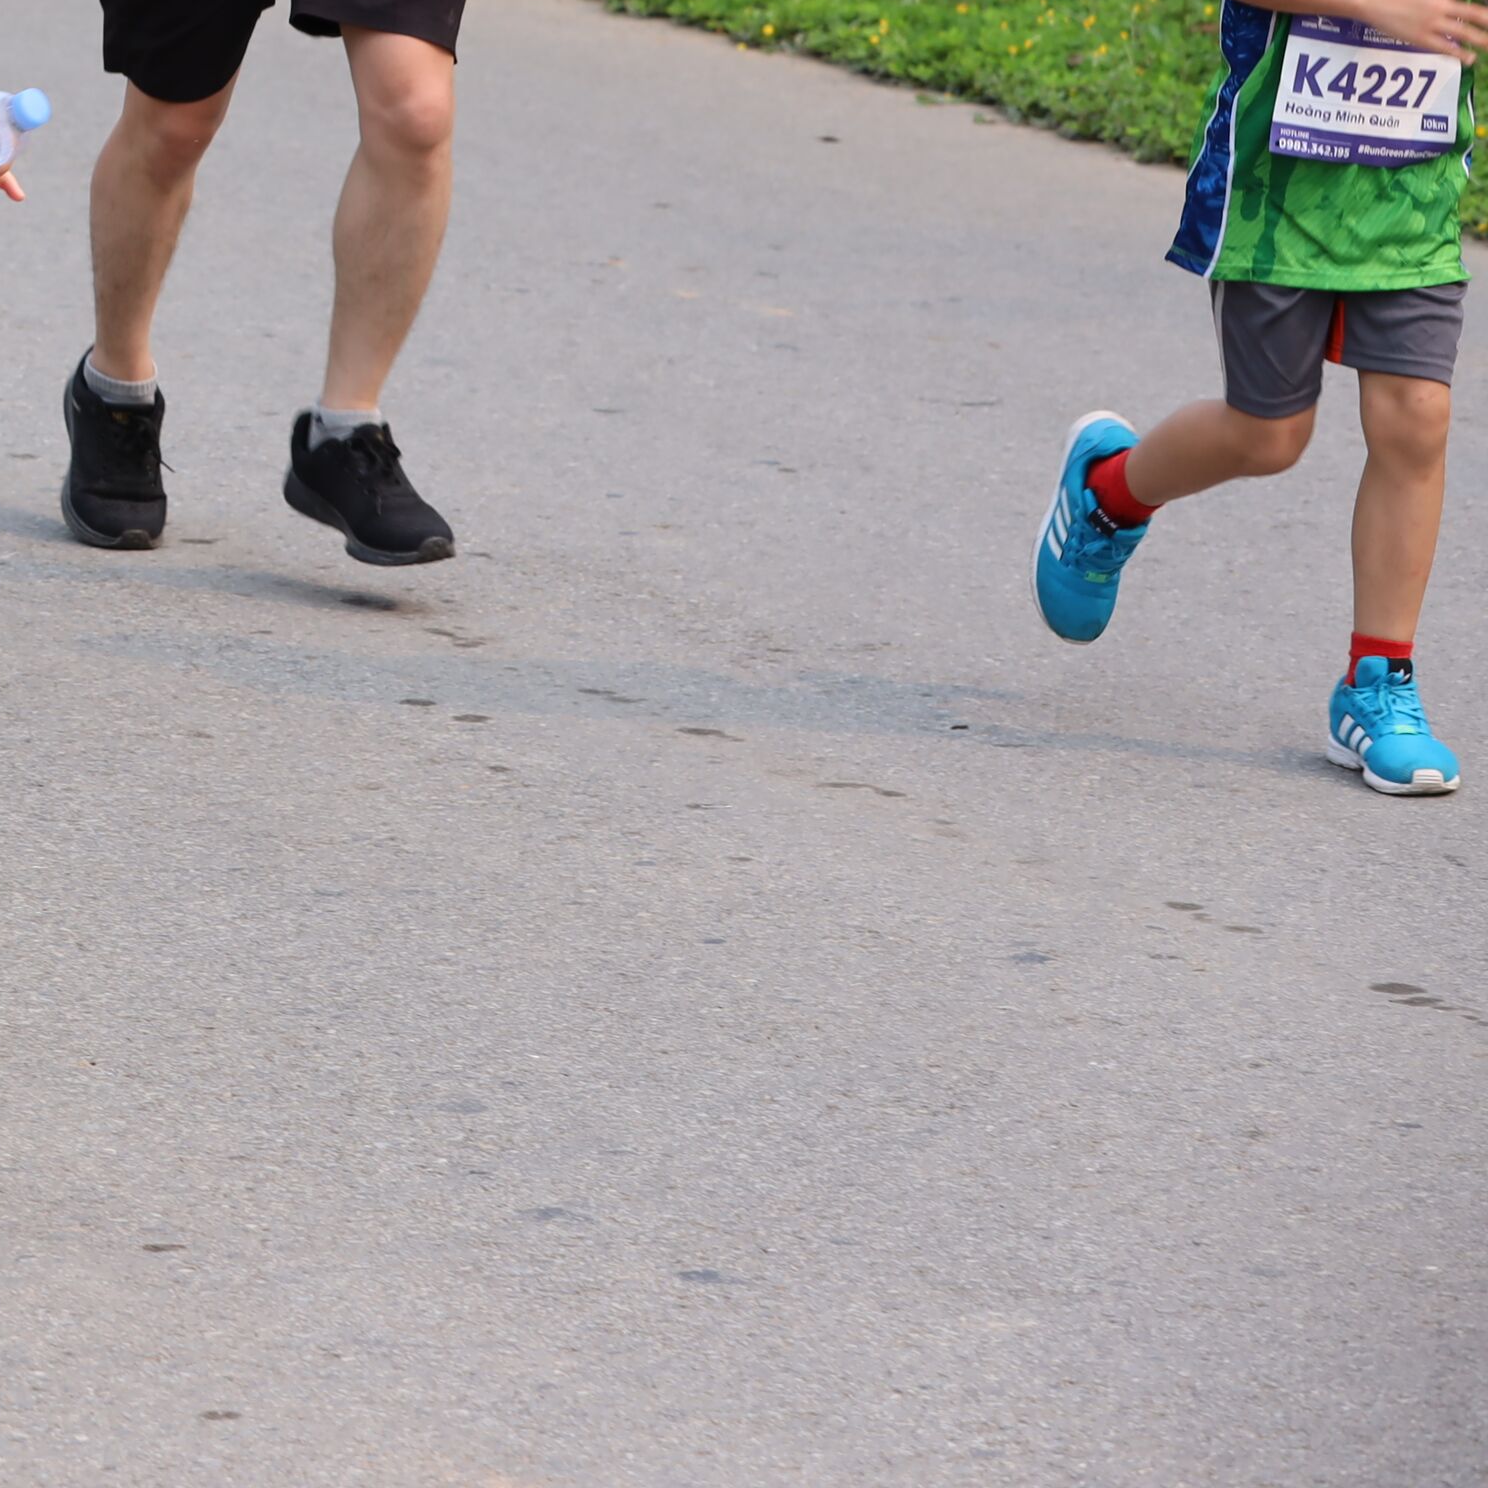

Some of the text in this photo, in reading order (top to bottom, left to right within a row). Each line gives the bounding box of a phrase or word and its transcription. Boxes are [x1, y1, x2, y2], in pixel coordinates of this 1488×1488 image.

[1292, 53, 1438, 109] K4227
[1335, 109, 1365, 125] Minh
[1423, 118, 1447, 131] 10km
[1280, 128, 1310, 140] HOTLINE
[1278, 137, 1351, 159] 0983.342.195
